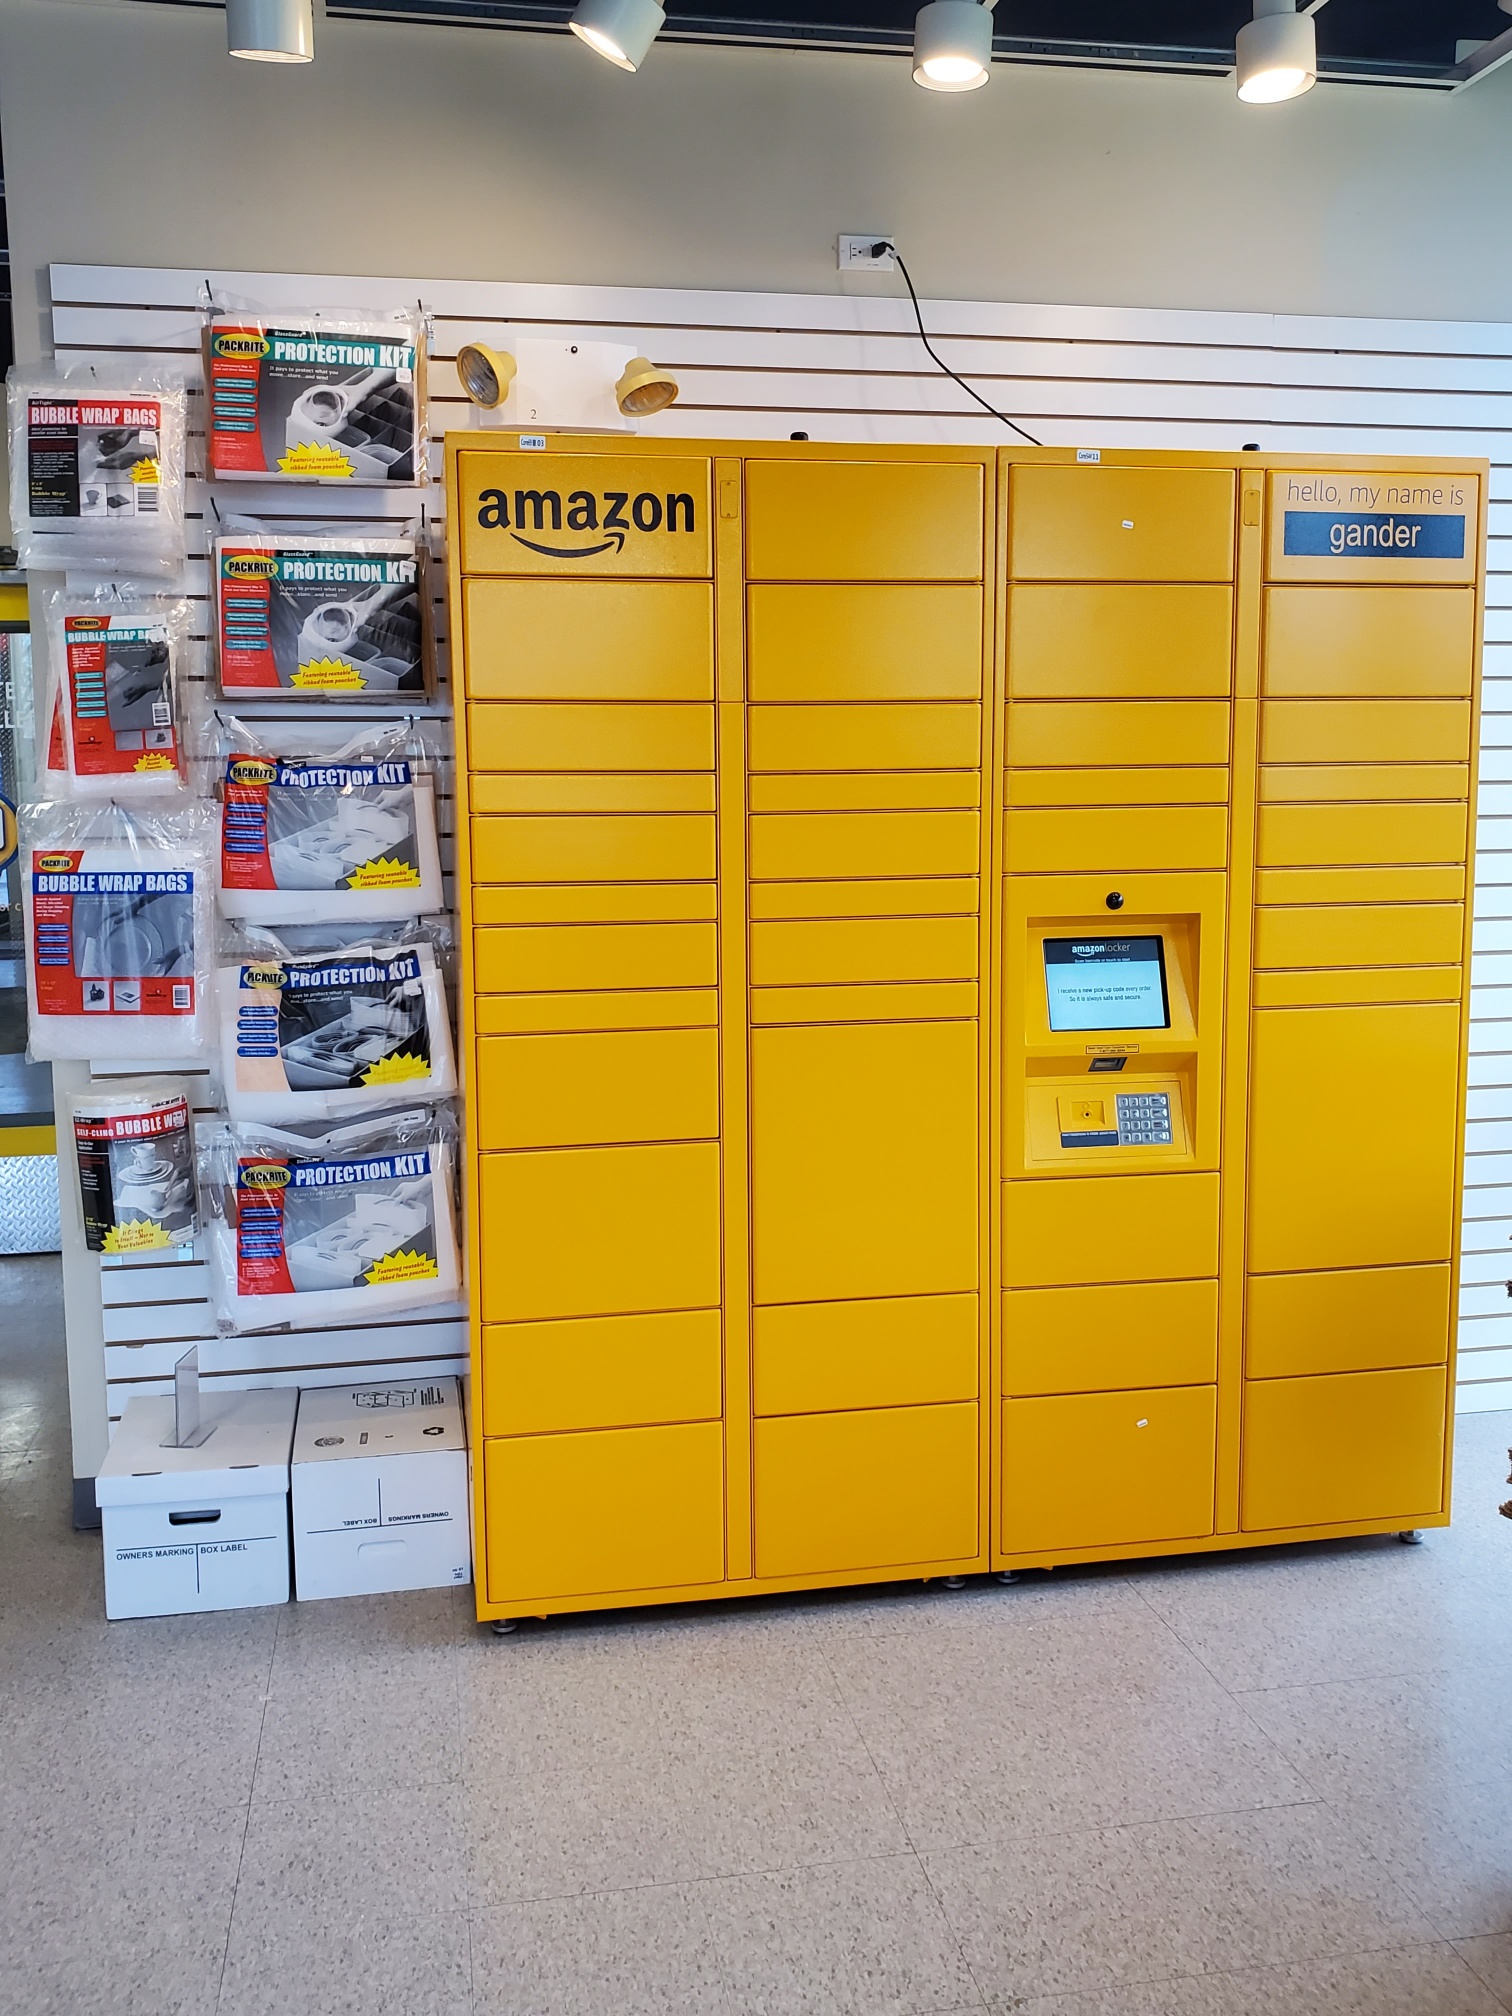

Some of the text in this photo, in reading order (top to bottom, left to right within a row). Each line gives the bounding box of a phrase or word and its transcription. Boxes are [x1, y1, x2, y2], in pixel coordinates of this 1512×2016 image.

[219, 340, 264, 352] PACKRITE
[274, 342, 412, 368] PROTECTION KIT
[32, 406, 157, 425] BUBBLE WRAP BAGS
[530, 409, 537, 420] 2
[1288, 479, 1464, 508] hello, my name is
[478, 488, 694, 532] amazon
[1330, 518, 1422, 554] gander
[229, 562, 274, 573] PACKRITE
[284, 562, 382, 582] PROTECTION
[68, 631, 106, 643] BUBBLE
[106, 630, 135, 641] WRAP
[302, 670, 328, 678] Featuring
[334, 677, 356, 685] pouches
[232, 766, 274, 780] PACKRITE
[281, 763, 406, 788] PROTECTION KIT
[38, 874, 188, 892] BUBBLE WRAP BAGS
[392, 878, 412, 886] pouches
[290, 958, 414, 988] PROTECTION KIT
[77, 1128, 114, 1137] SELF-CLING
[116, 1116, 162, 1136] BUBBLE
[244, 1171, 288, 1182] PACKRITE
[296, 1154, 426, 1186] PROTECTION KIT
[378, 1262, 424, 1275] Featuring reusable
[409, 1268, 430, 1277] pouches
[388, 1514, 420, 1522] MARKINGS
[116, 1548, 194, 1560] OWNERS MARKING
[200, 1544, 248, 1554] BOX LABEL
